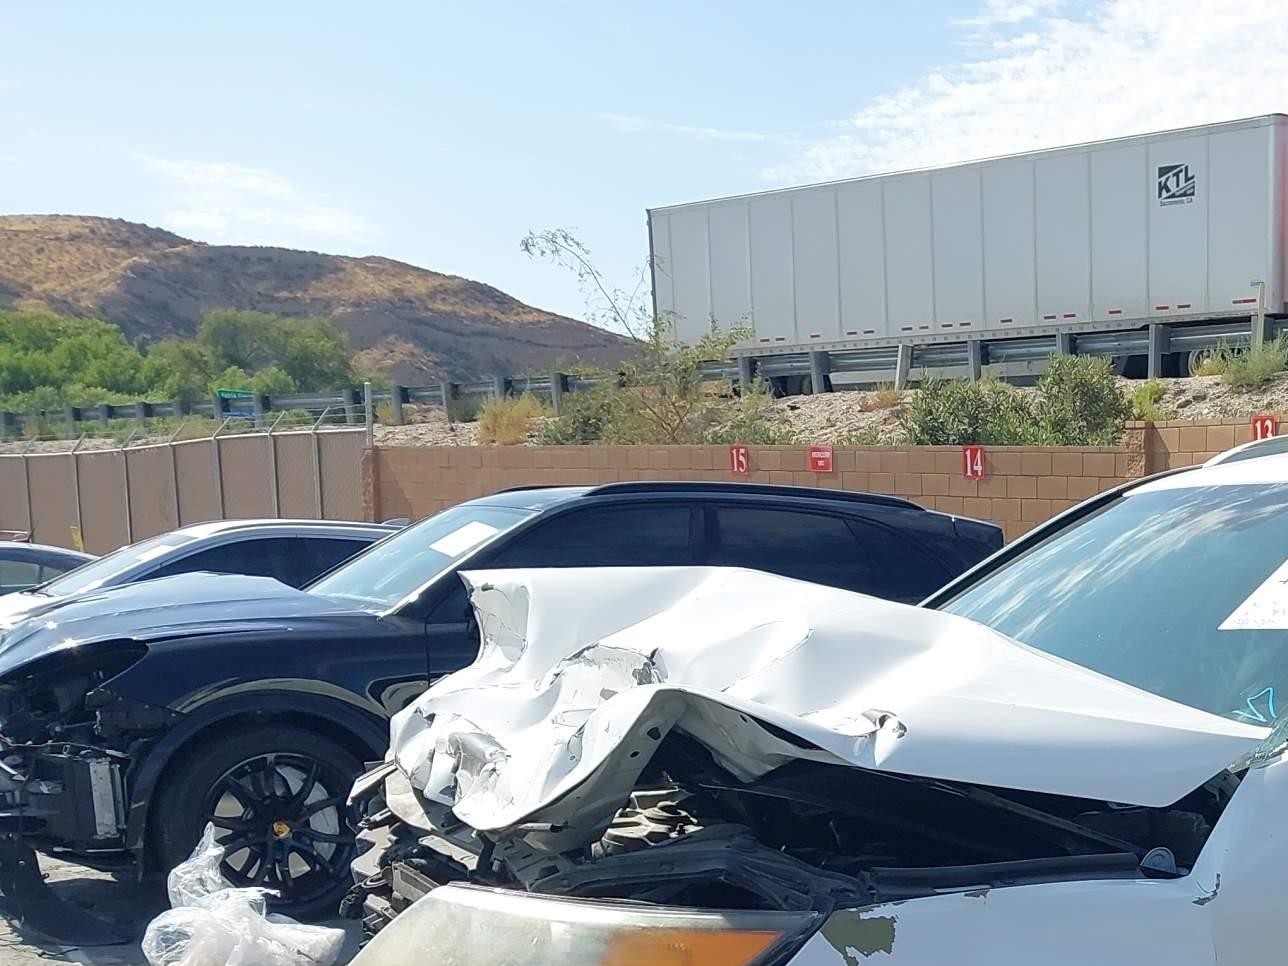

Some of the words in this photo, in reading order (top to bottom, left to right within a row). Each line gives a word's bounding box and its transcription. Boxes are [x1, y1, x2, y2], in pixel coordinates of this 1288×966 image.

[1158, 165, 1195, 199] KTL
[732, 448, 746, 472] 15
[965, 449, 982, 476] 14
